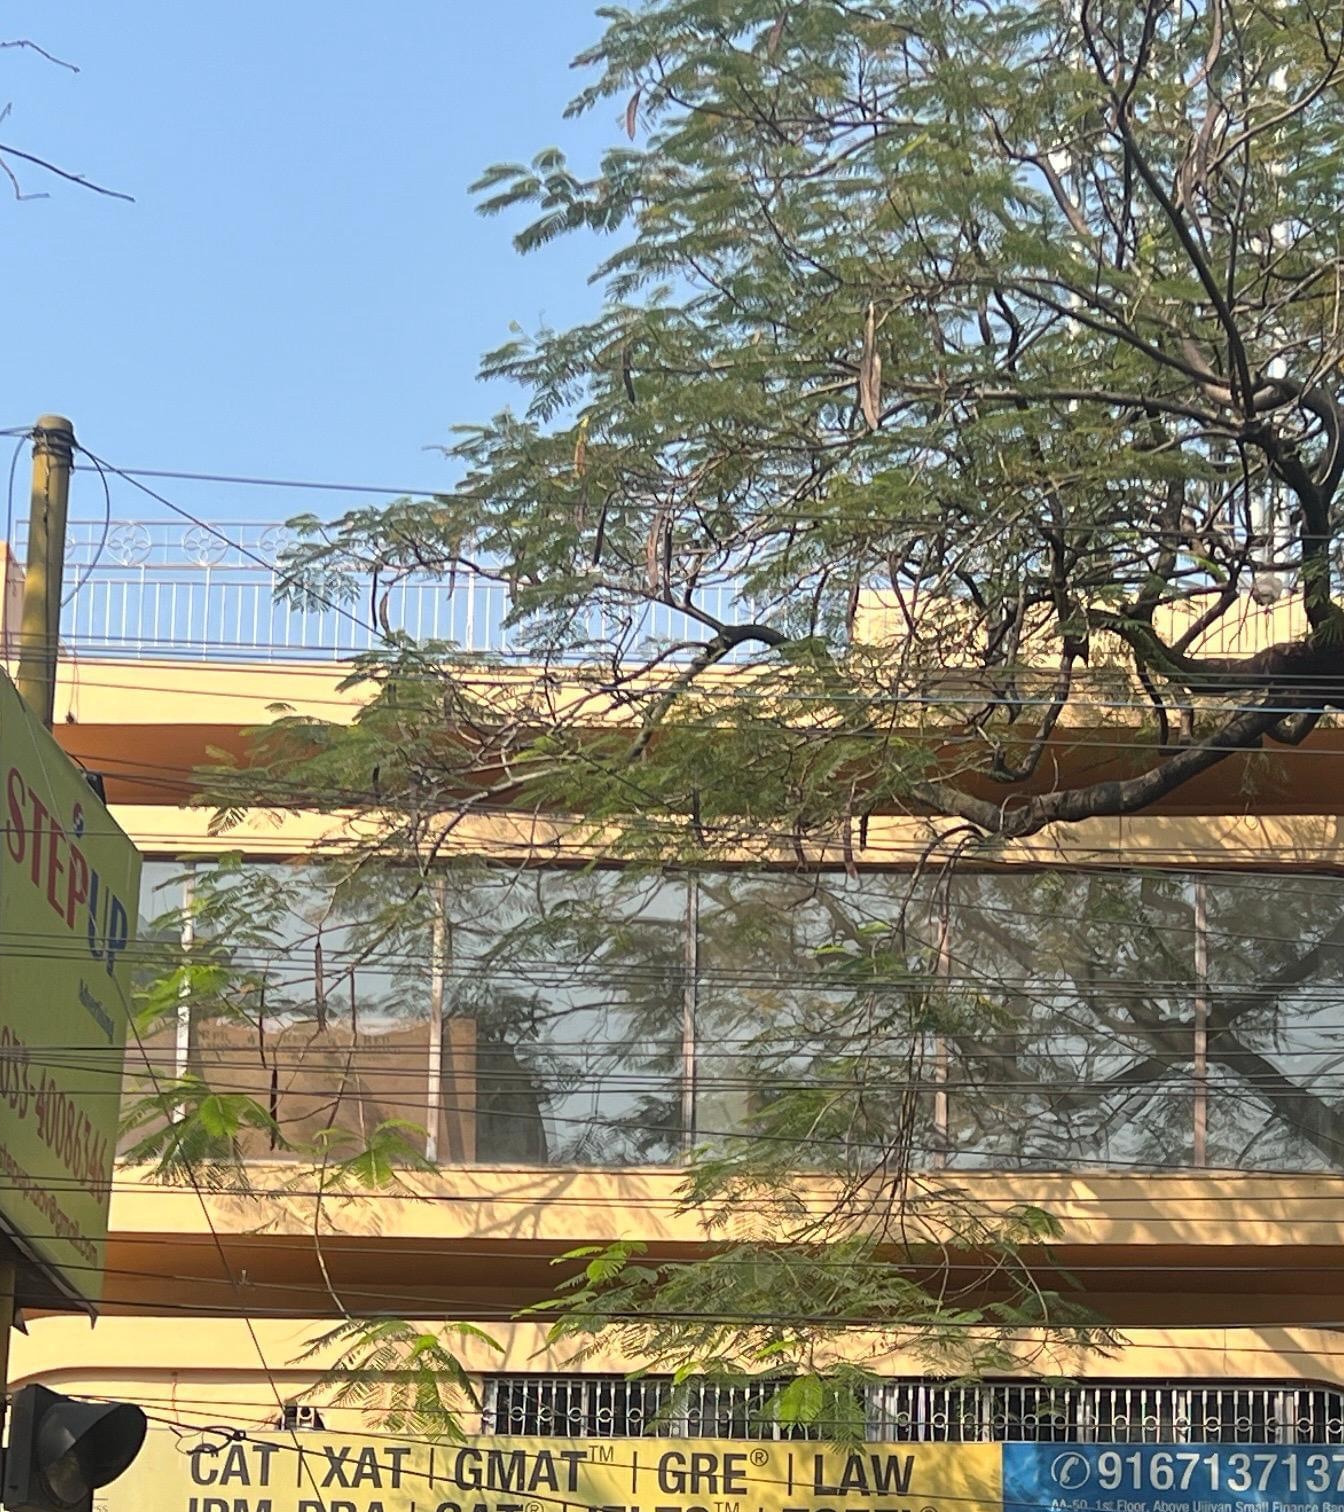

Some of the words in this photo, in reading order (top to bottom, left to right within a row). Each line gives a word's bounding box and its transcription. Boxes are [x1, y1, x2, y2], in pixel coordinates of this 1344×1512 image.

[191, 1444, 279, 1486] CAT
[321, 1447, 410, 1488] XAT
[814, 1454, 915, 1496] LAW
[1154, 1501, 1189, 1512] Above
